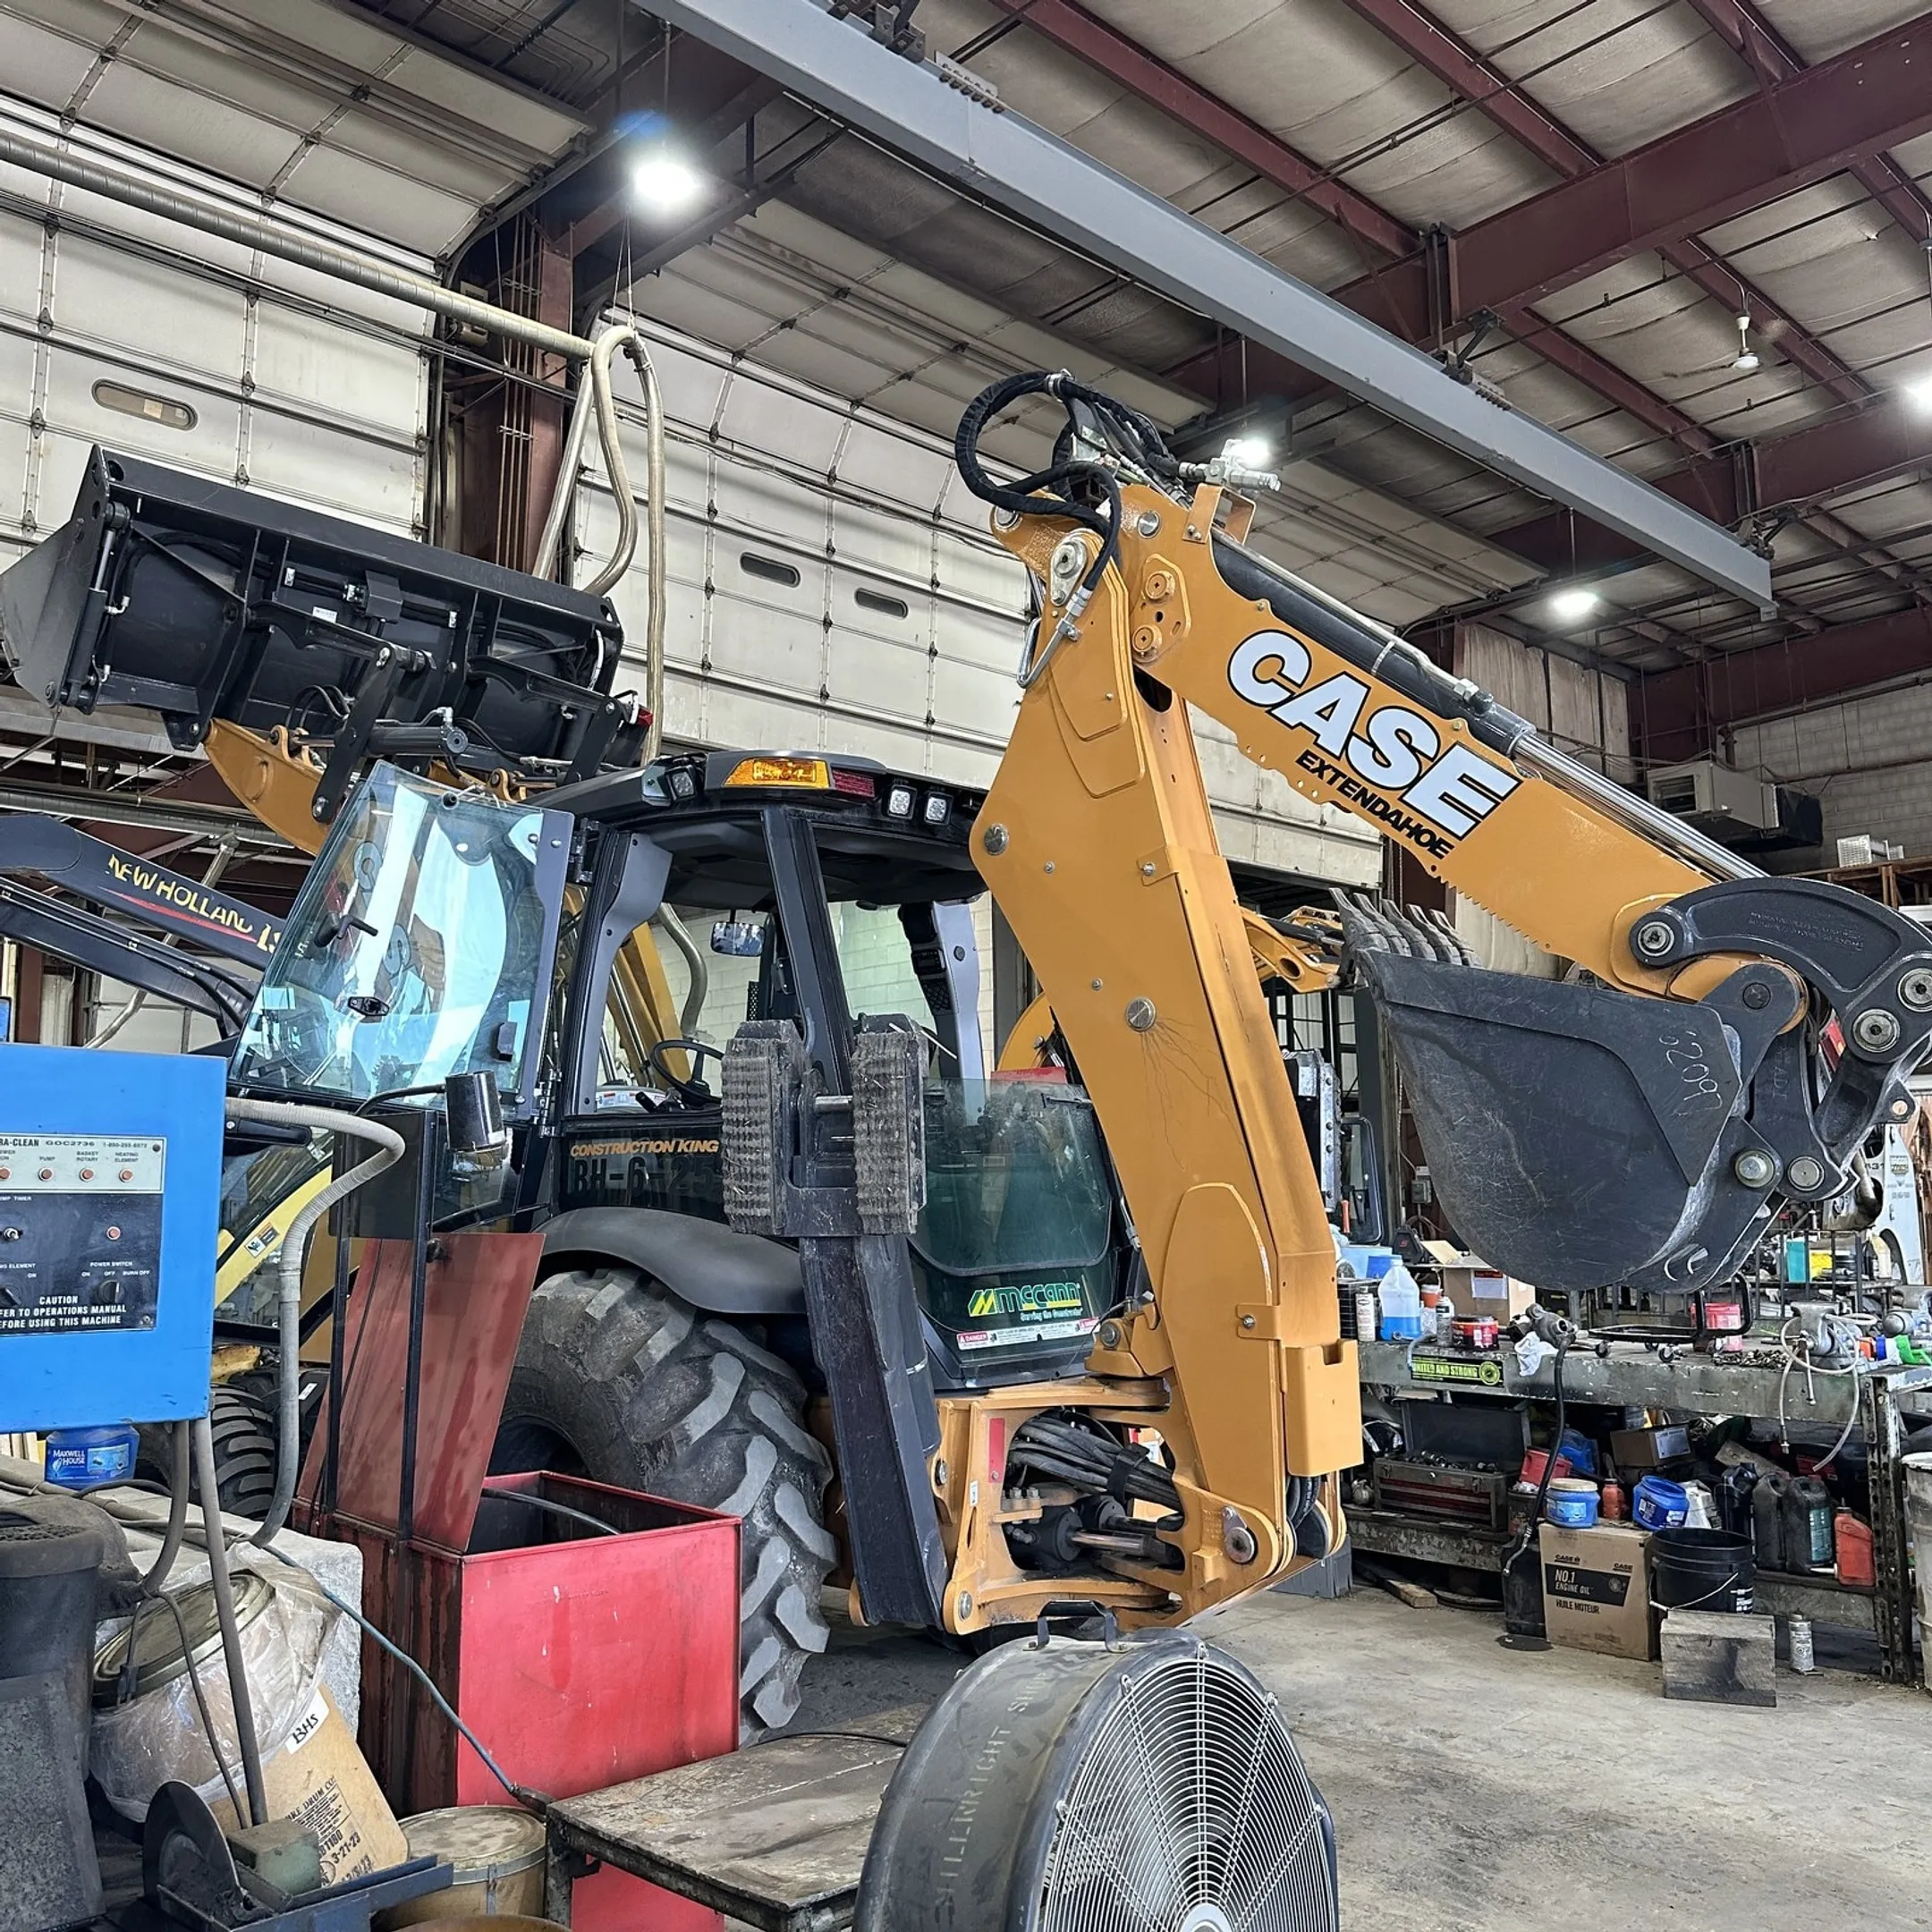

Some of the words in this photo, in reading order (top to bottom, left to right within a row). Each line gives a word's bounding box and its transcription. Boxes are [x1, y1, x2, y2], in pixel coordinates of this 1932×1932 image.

[1227, 629, 1524, 842] CASE
[1295, 749, 1455, 860] EXTENDAHOE
[105, 854, 158, 890] NEW
[571, 1140, 675, 1157] CONSTRUCTION
[677, 1140, 719, 1153] KING
[39, 1296, 79, 1305] CAUTION
[19, 1308, 30, 1318] TO
[33, 1306, 88, 1317] OPERATIONS
[90, 1304, 127, 1314] MANUAL
[29, 1318, 55, 1327] USING
[59, 1318, 79, 1326] THIS
[81, 1316, 122, 1326] MACHINE
[1436, 1364, 1450, 1376] AND
[1450, 1366, 1478, 1377] STRONG
[53, 1449, 86, 1459] MAXWELL
[63, 1458, 86, 1466] HOUSE
[1555, 1569, 1576, 1584] NO.1
[1555, 1581, 1579, 1593] ENGINE
[1556, 1599, 1573, 1610] HUILE
[1574, 1602, 1600, 1614] MOTEUR
[303, 1787, 324, 1810] DRUM
